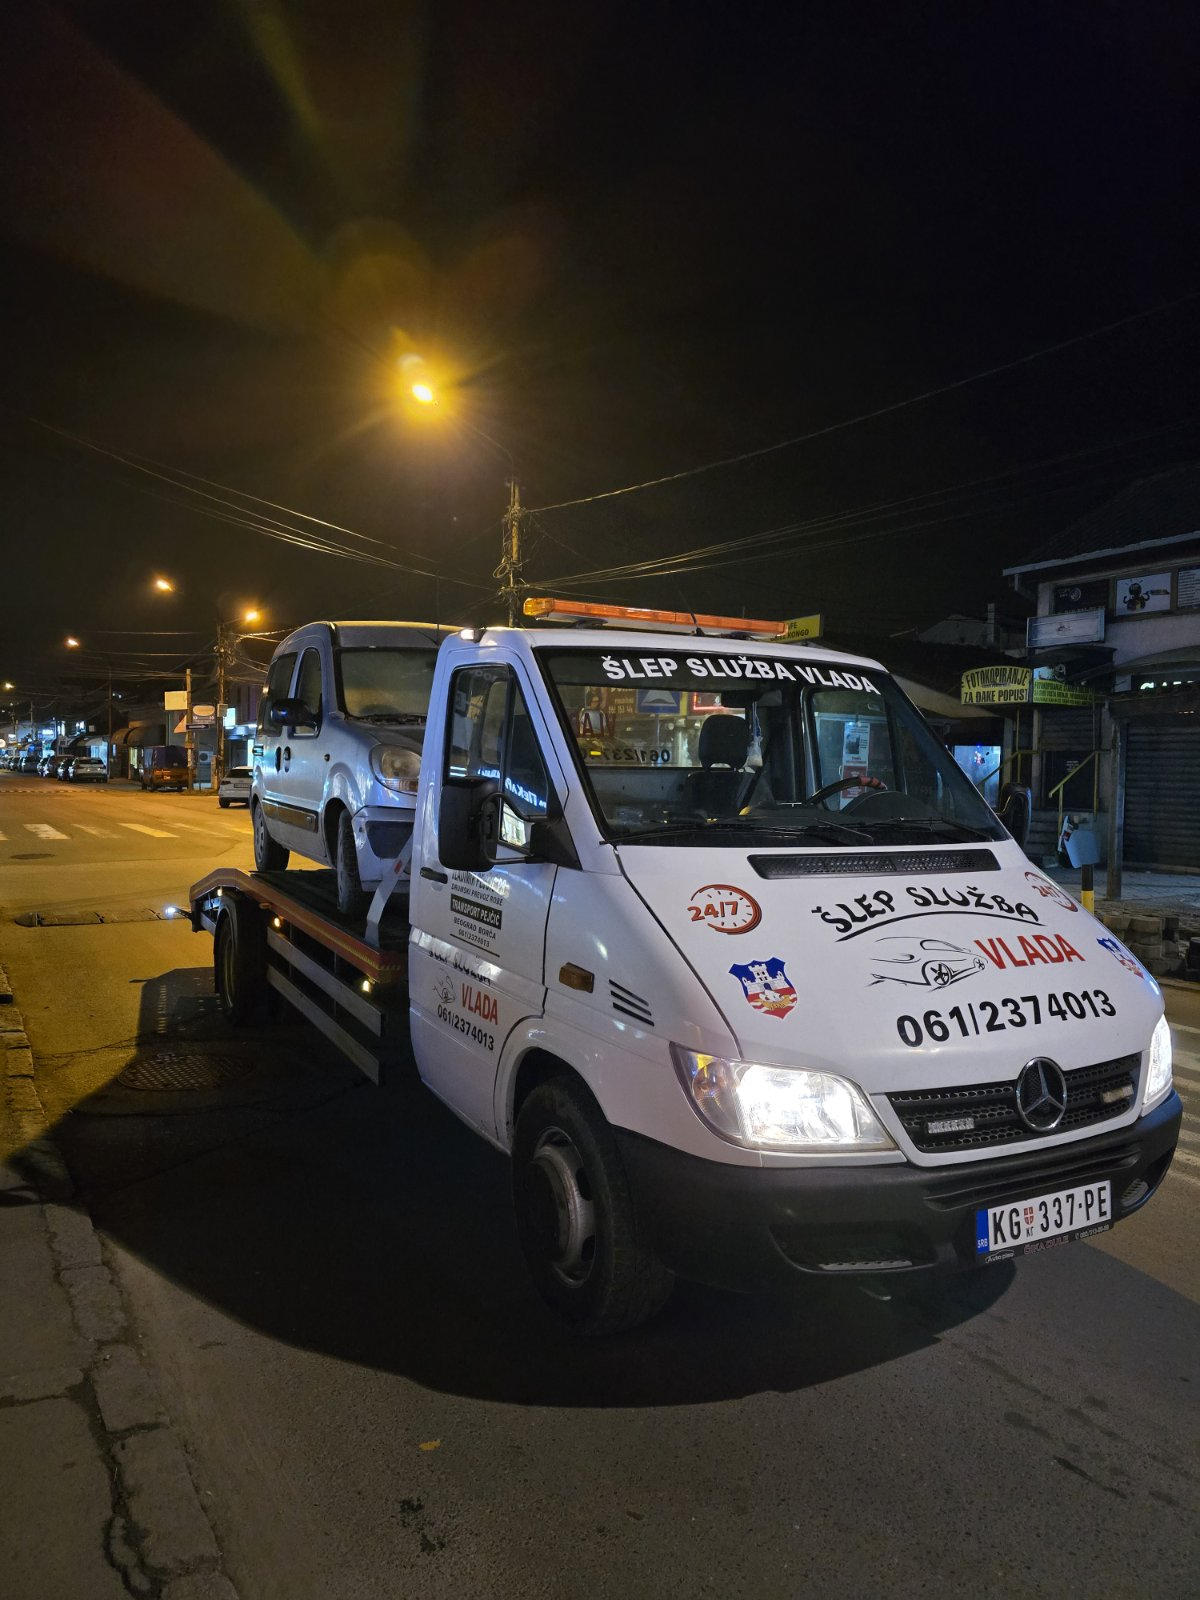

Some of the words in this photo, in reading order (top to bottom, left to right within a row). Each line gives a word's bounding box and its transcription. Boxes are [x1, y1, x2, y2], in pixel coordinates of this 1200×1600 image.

[788, 629, 809, 639] KONGO
[601, 655, 678, 680] ŠLEP
[685, 655, 797, 681] SLUŽBA
[794, 665, 881, 695] VLADA
[966, 667, 1030, 690] FOTOKOPIRANJE
[964, 692, 973, 703] ZA
[998, 689, 1028, 702] POPUST
[452, 898, 480, 918] TRANSPORT
[687, 901, 738, 921] 24/7
[811, 889, 894, 933] ŠLEP
[906, 885, 1039, 922] SLUŽBA
[454, 916, 477, 931] BEOGRAD
[973, 933, 1086, 970] VLADA
[461, 982, 498, 1025] VLADA
[897, 988, 1117, 1048] 061/2374013
[437, 1004, 494, 1051] 061/2374013
[992, 1207, 1021, 1245] KG
[977, 1238, 988, 1249] SRB
